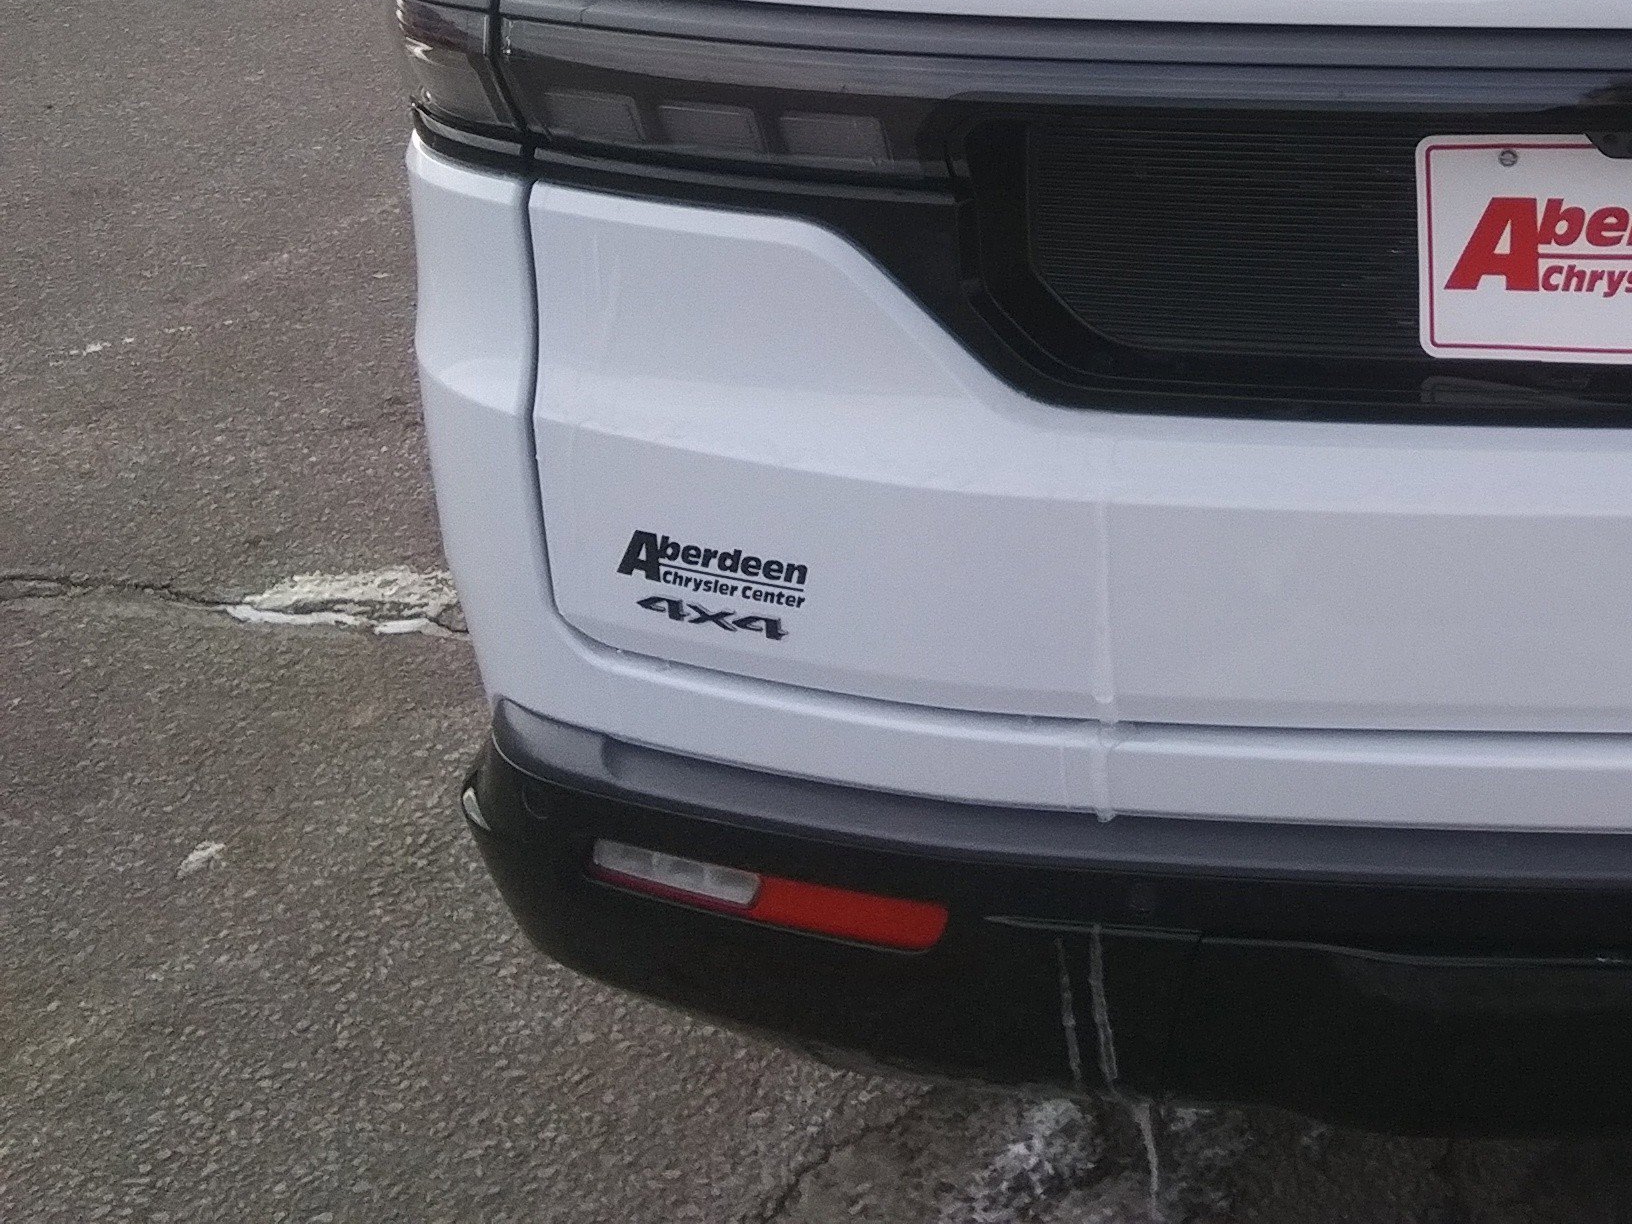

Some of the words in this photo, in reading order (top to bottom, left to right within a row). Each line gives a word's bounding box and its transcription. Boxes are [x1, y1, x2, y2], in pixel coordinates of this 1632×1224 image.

[616, 529, 808, 586] Aberdeen
[662, 569, 739, 598] Chrysler
[741, 585, 806, 608] Center
